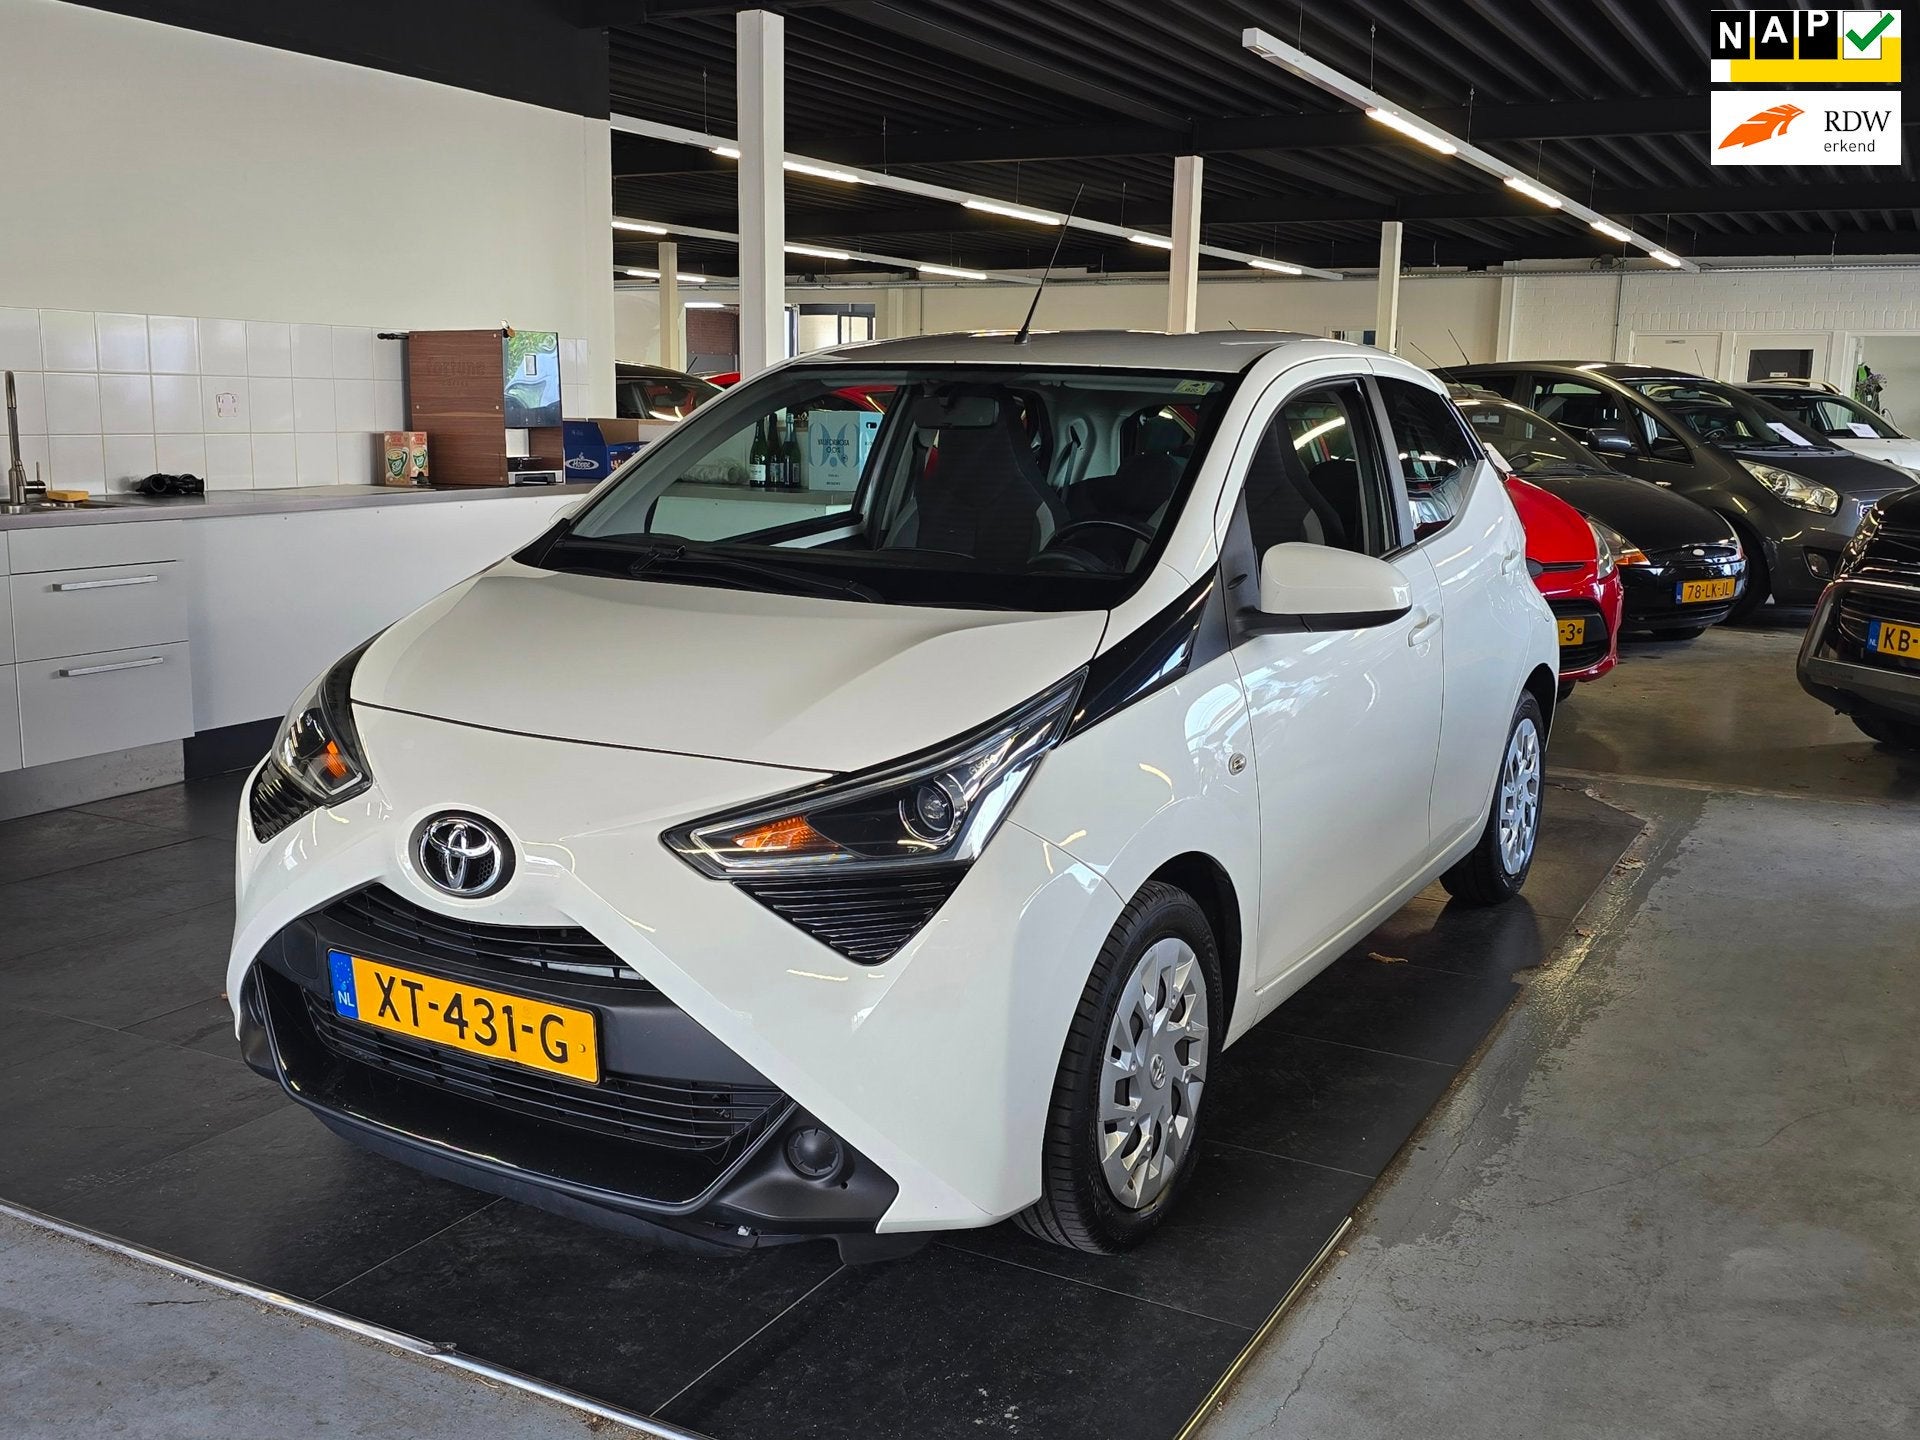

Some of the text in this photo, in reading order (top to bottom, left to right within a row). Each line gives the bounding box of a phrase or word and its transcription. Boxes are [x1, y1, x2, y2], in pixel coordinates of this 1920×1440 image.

[1687, 581, 1730, 600] 78-LK-JL
[337, 971, 569, 1064] NL XT-431-G
